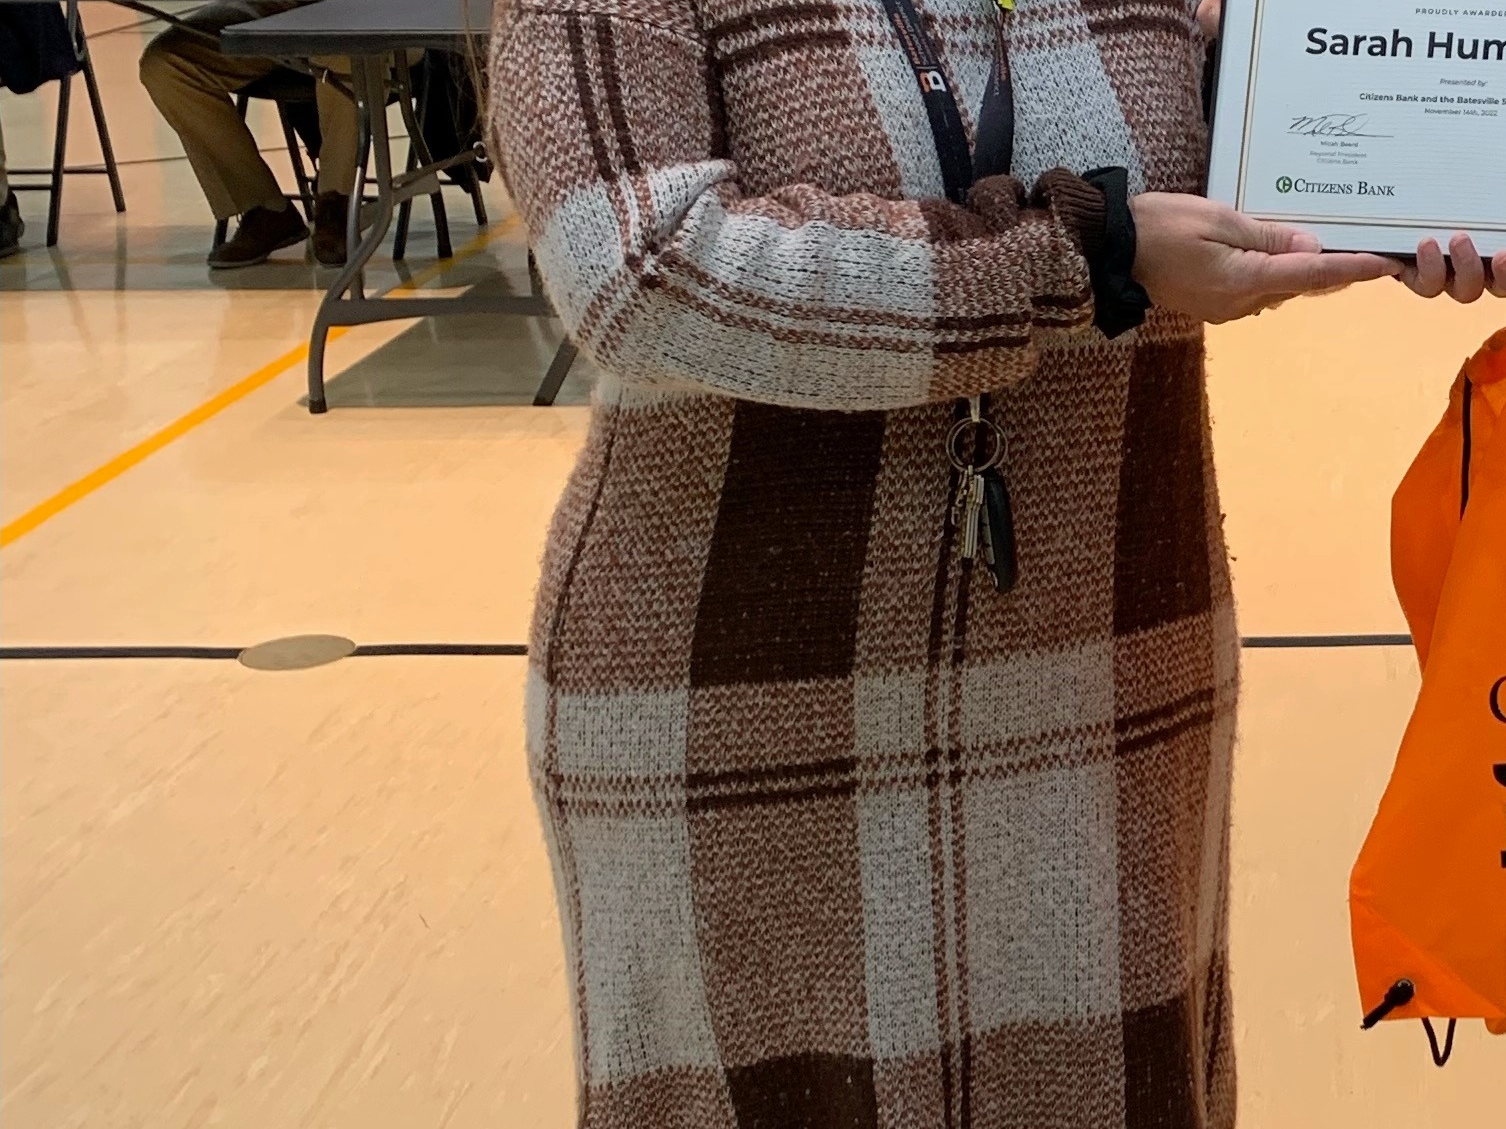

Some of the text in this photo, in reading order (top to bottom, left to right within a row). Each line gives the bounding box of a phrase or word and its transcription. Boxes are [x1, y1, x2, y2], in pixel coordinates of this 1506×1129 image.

[1415, 8, 1459, 16] PROUDLY
[1305, 27, 1413, 58] Sarah
[1439, 78, 1477, 87] Presented
[1359, 92, 1394, 102] Citizens
[1396, 94, 1419, 103] Bank
[1420, 95, 1438, 103] and
[1439, 96, 1455, 104] the
[1457, 96, 1500, 106] Batesville
[1424, 108, 1462, 116] November
[1294, 178, 1395, 196] CITIZENS BANK
